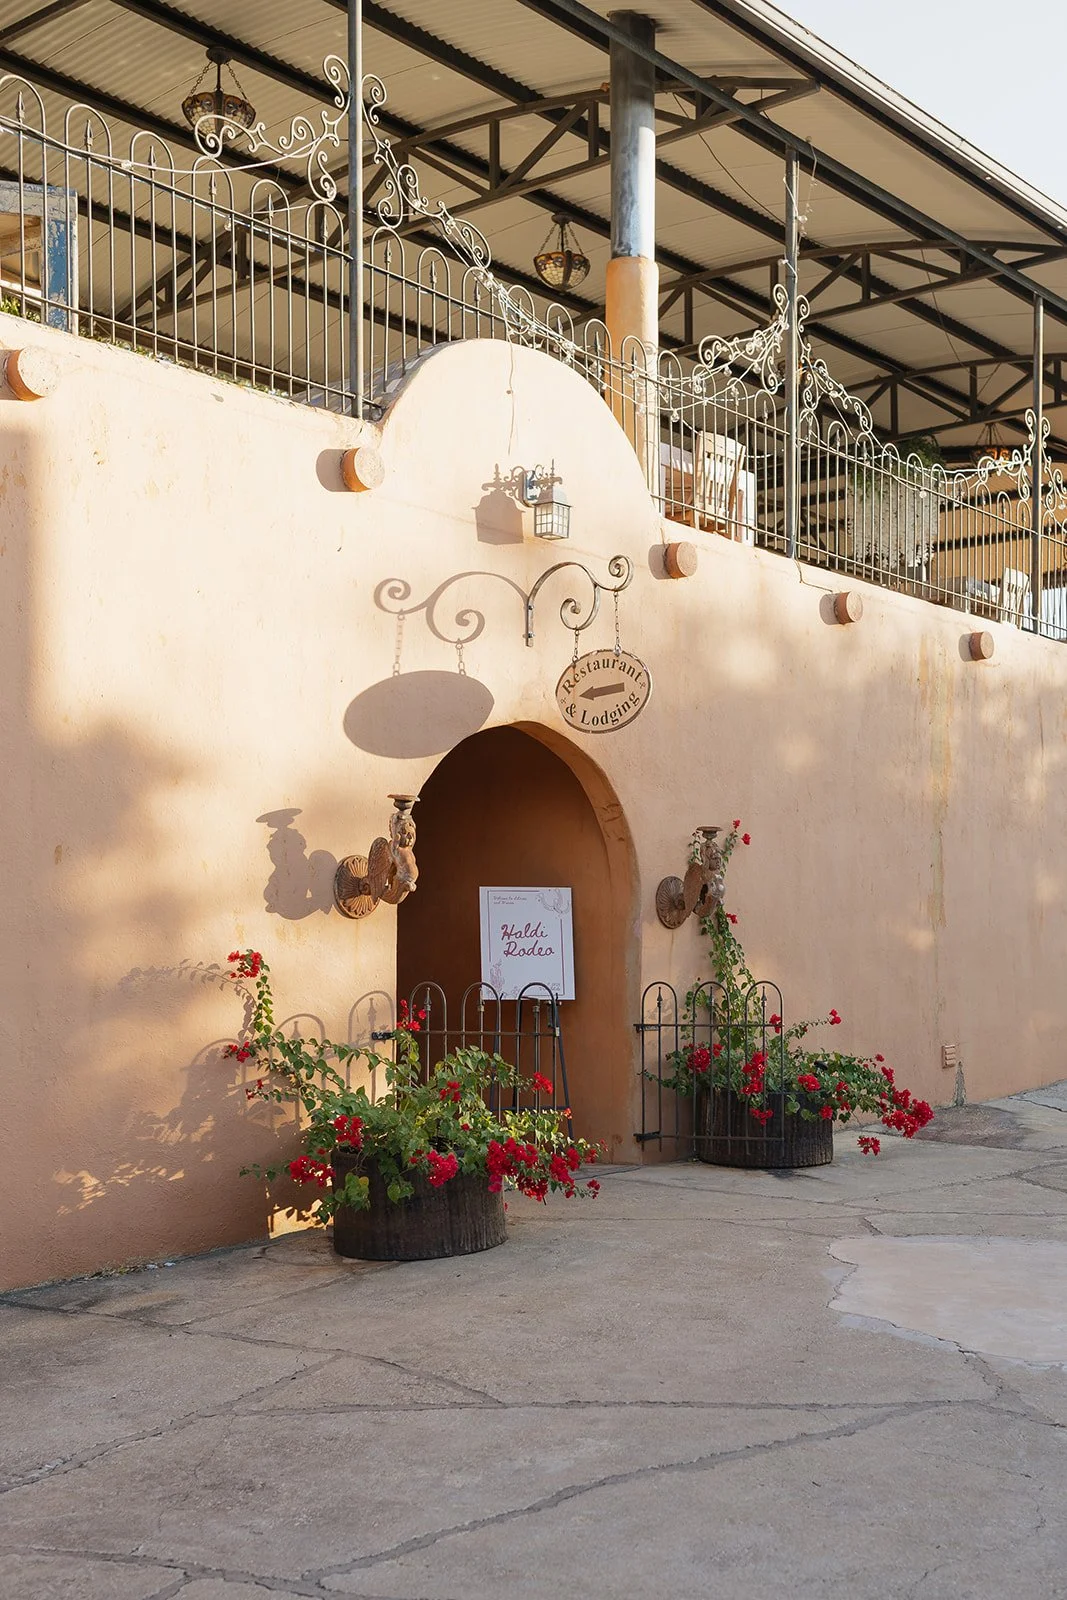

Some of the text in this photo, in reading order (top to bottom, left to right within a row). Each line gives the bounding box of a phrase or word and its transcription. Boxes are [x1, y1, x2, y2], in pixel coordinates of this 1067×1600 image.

[562, 658, 642, 694] Restaurant
[565, 691, 640, 726] & Lodging
[501, 921, 548, 940] Haldi
[503, 940, 555, 957] Rodeo
